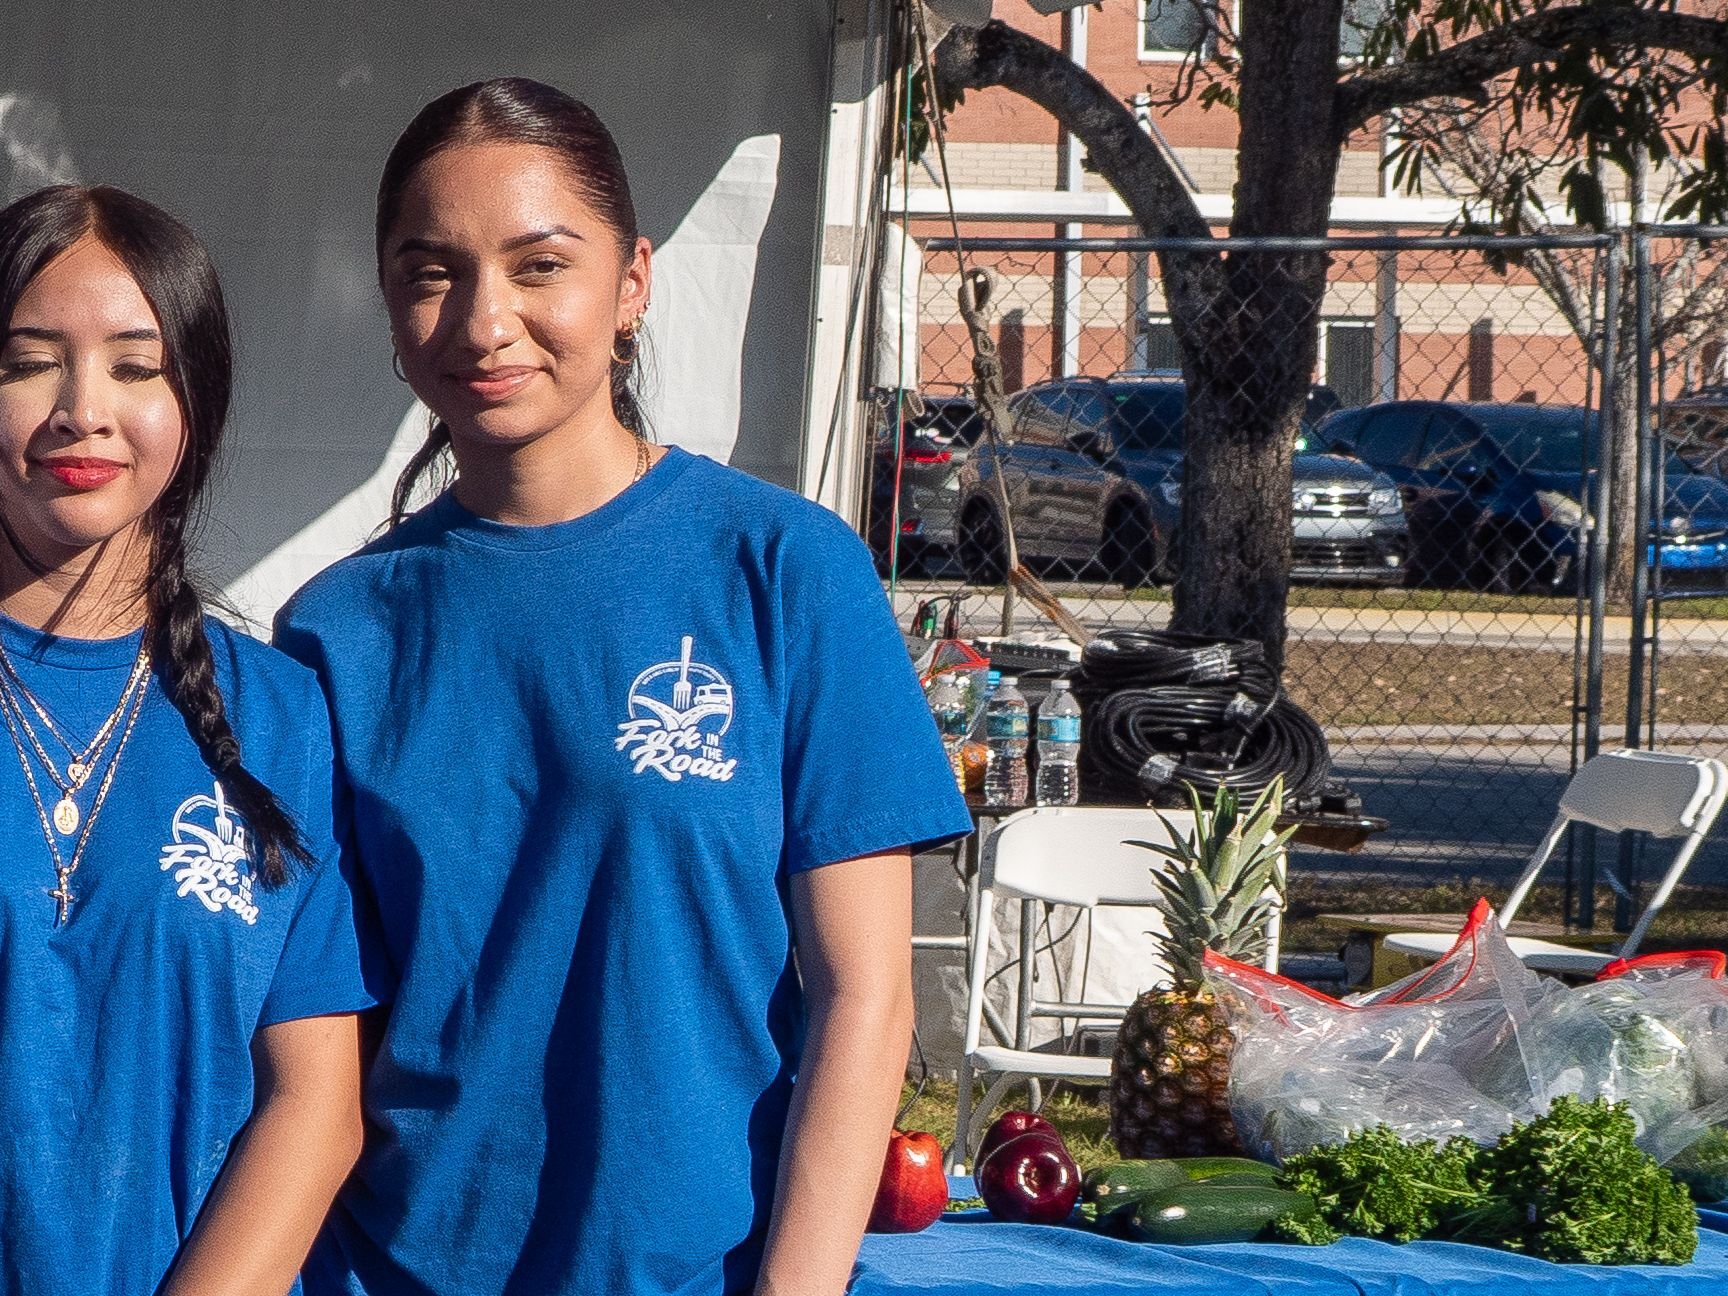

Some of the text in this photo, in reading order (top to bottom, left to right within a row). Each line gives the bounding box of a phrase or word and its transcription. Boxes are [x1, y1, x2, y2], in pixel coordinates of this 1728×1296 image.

[614, 718, 702, 752] Fork
[706, 732, 719, 747] IN
[630, 745, 737, 782] Road
[701, 745, 724, 762] THE
[159, 843, 240, 885] Fork
[175, 868, 260, 926] Road
